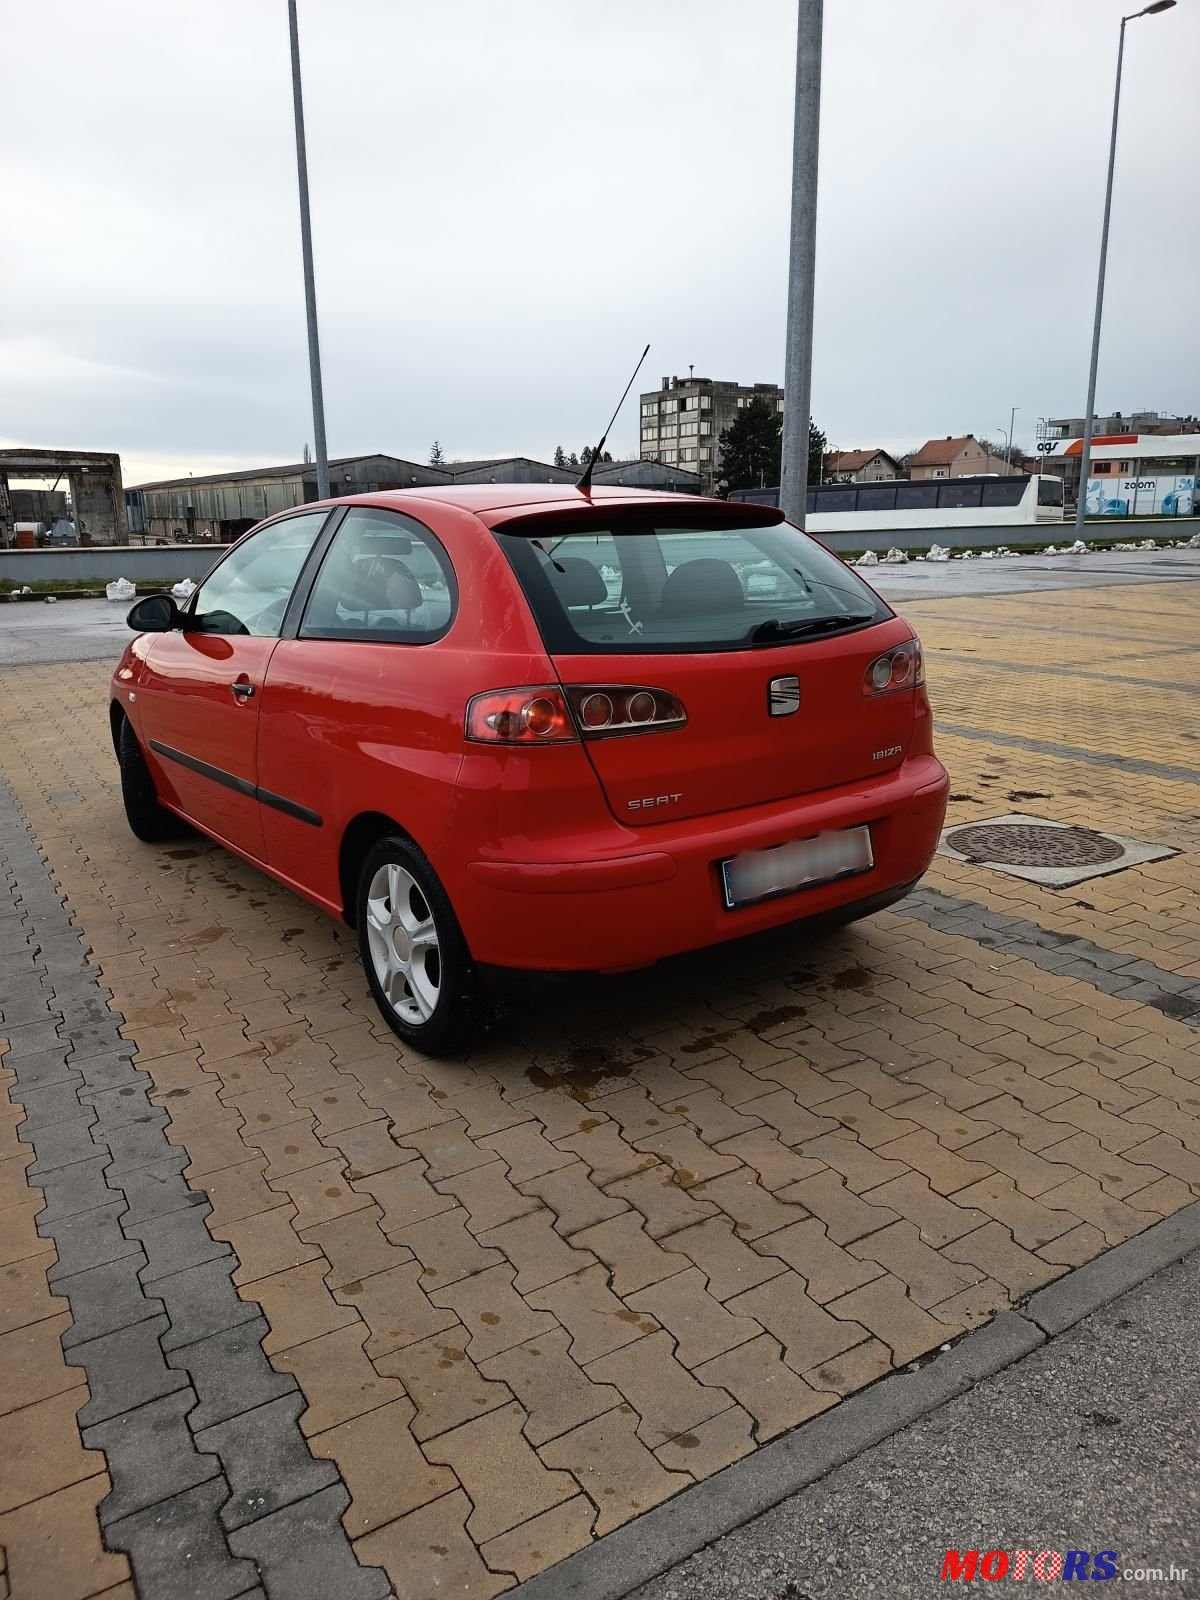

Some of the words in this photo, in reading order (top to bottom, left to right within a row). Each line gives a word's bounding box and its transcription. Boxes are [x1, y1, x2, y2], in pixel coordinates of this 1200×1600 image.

[1037, 441, 1059, 454] ags
[1124, 481, 1155, 490] zoom
[872, 745, 902, 760] IBIZA
[627, 793, 682, 810] SEAT
